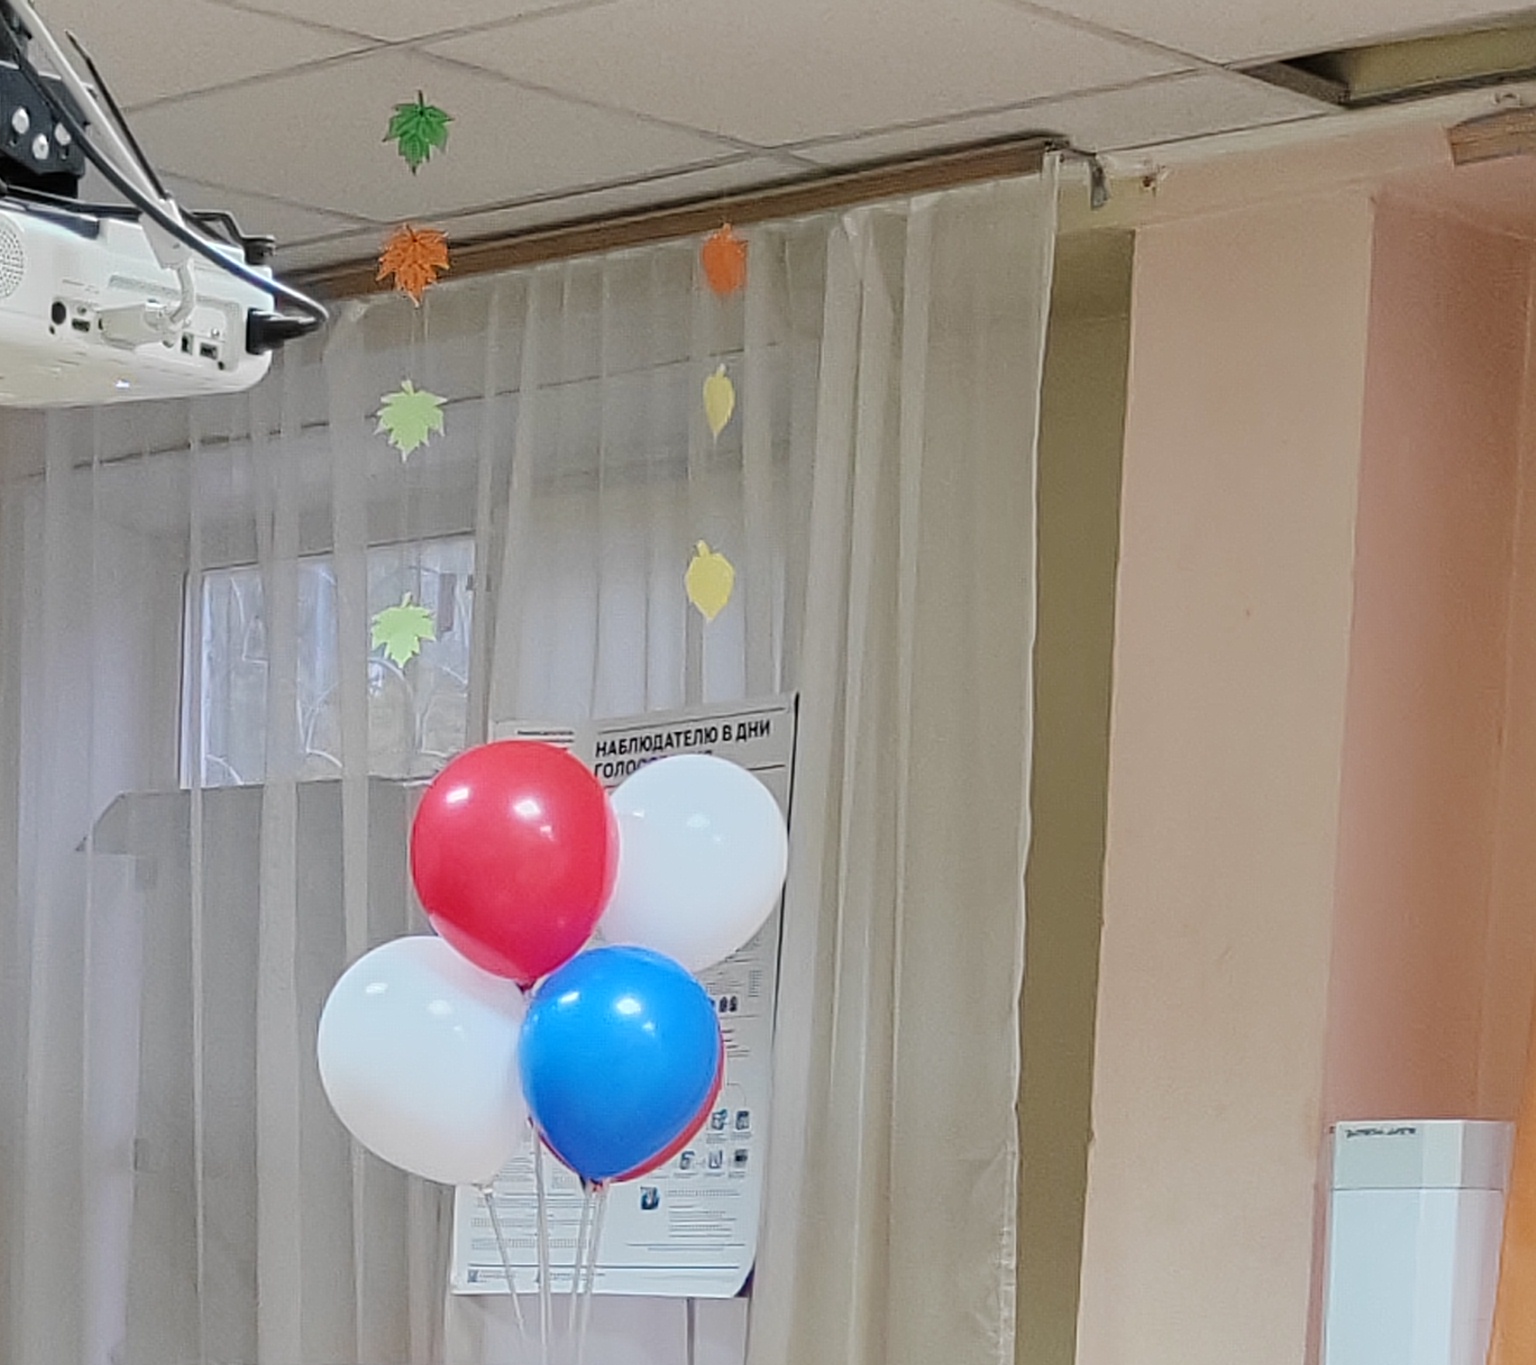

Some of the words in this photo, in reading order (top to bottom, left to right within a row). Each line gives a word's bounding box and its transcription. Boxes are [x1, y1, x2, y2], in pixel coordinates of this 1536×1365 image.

[594, 725, 719, 758] НАБЛЮДАТЕЛЮ
[721, 724, 733, 742] В
[735, 719, 771, 742] ДНИ
